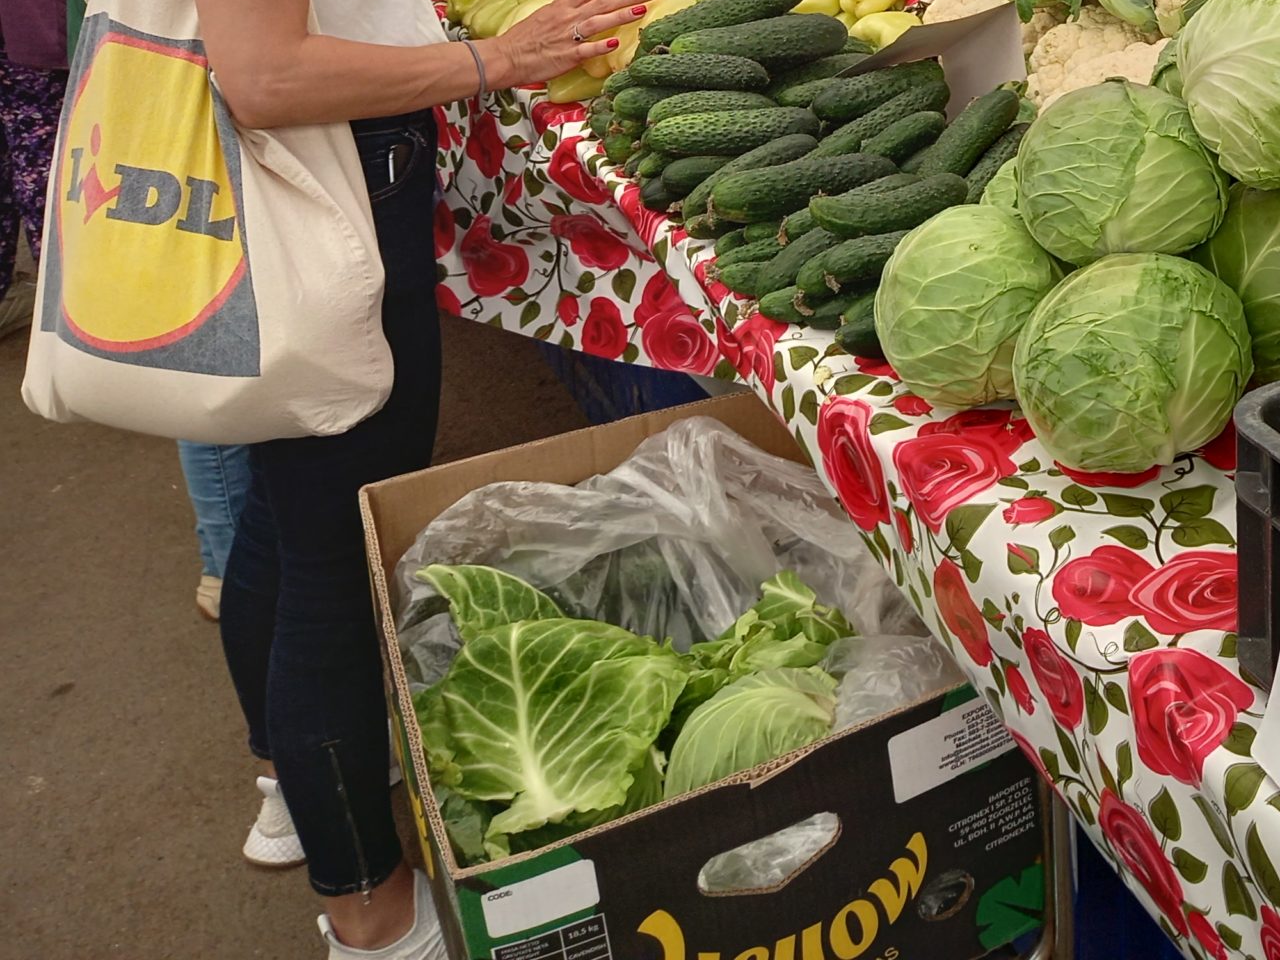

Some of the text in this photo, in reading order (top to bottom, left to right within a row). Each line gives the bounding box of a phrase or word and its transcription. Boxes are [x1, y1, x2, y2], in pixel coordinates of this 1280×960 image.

[948, 806, 990, 832] CITRONEX
[987, 793, 1033, 822] ZGORZELEC
[1001, 811, 1035, 833] POLAND
